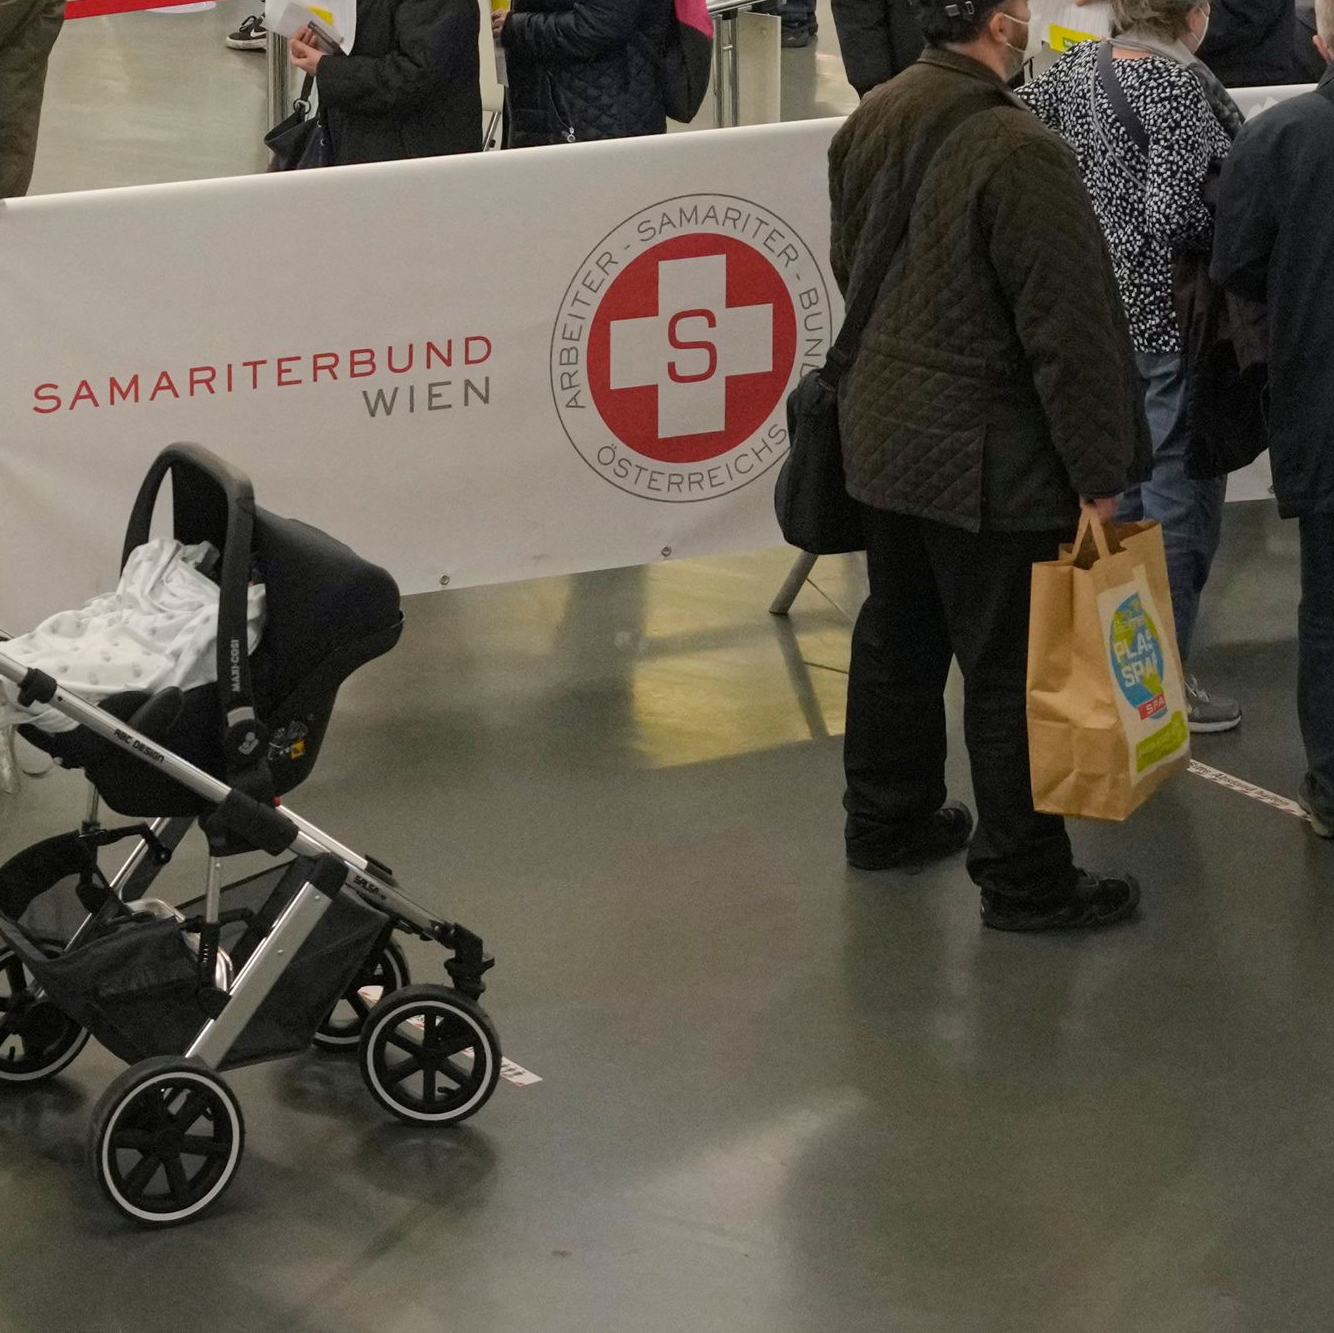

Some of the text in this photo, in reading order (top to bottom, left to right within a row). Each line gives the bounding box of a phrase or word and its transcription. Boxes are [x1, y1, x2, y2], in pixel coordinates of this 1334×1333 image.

[560, 251, 618, 409] ARBEITER
[637, 205, 799, 268] SAMARITER
[33, 335, 494, 415] SAMARITERBUND
[668, 309, 717, 383] S
[362, 375, 492, 419] WIEN
[597, 423, 788, 494] ÖSTERREICHS
[114, 729, 165, 763] ABC DESIGN
